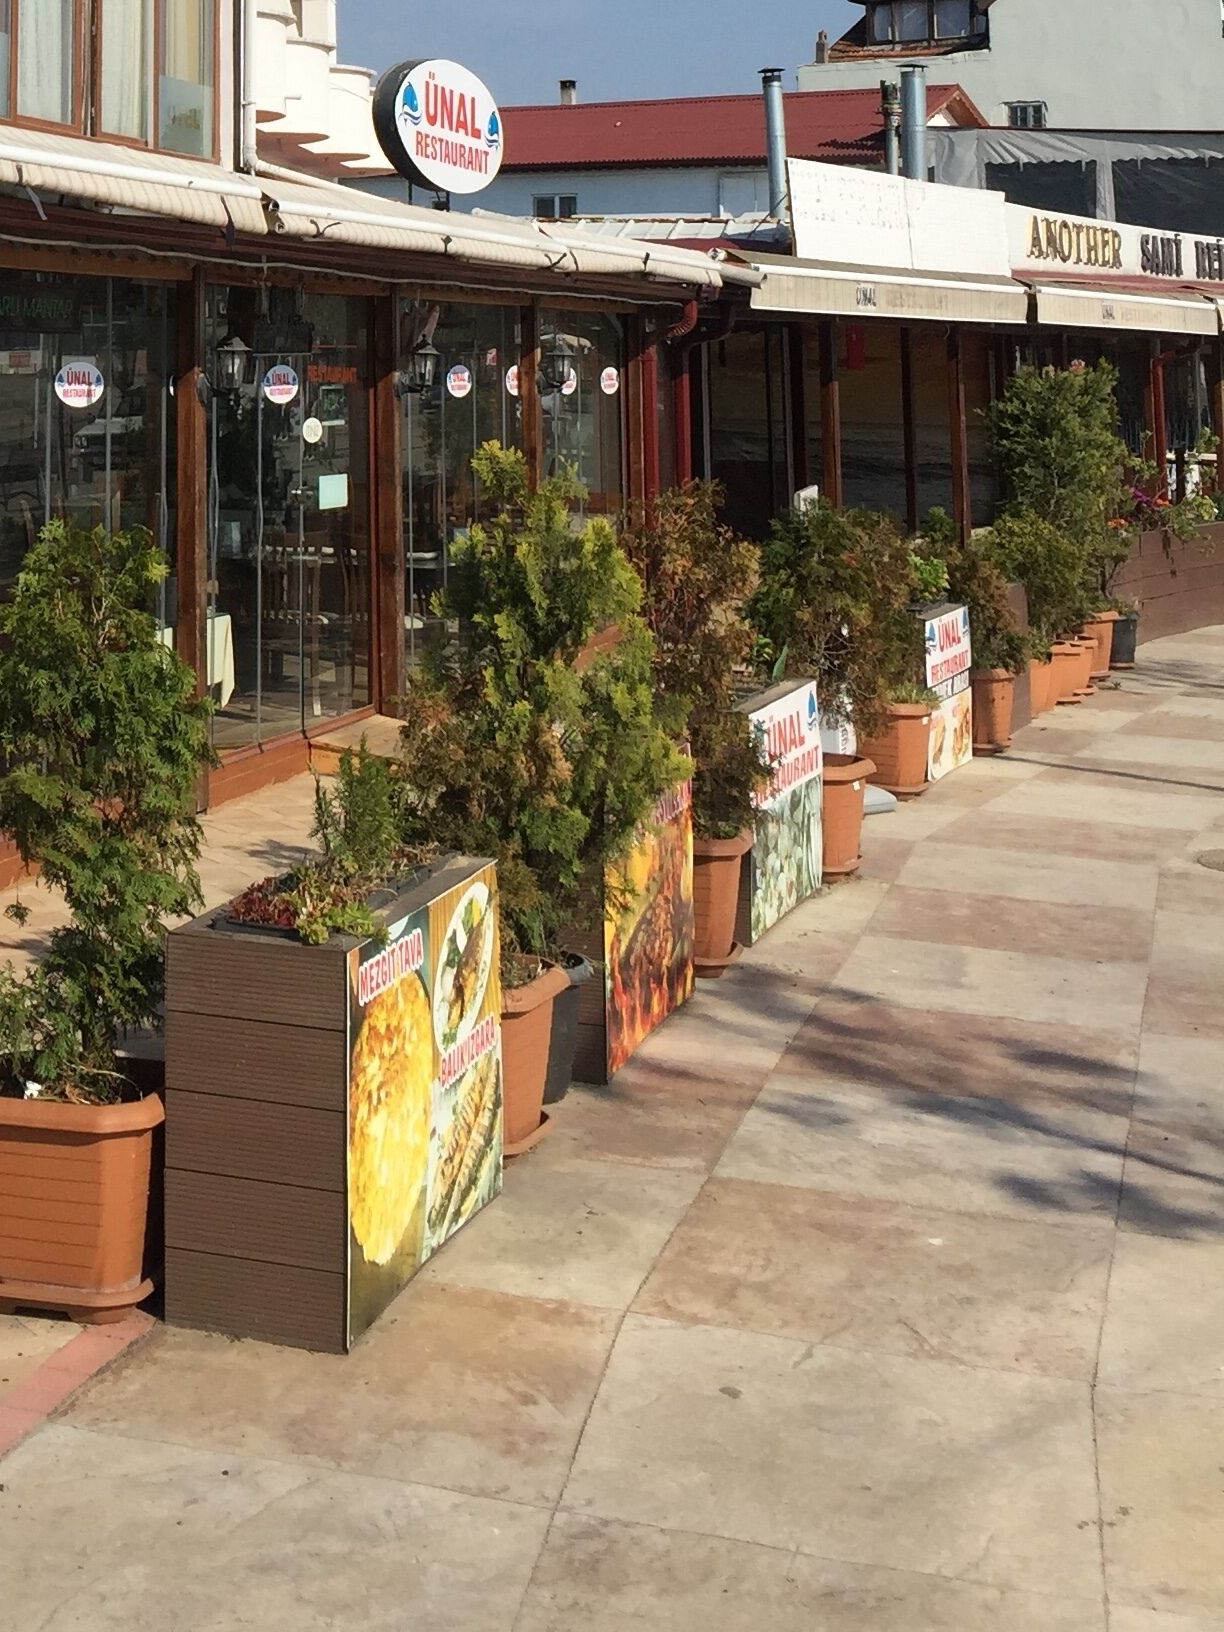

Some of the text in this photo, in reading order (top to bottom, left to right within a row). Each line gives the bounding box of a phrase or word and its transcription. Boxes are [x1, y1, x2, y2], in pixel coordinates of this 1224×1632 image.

[425, 71, 482, 140] ÜNAL
[415, 130, 490, 175] RESTAURANT
[1027, 215, 1123, 269] ANOTHER
[66, 367, 93, 386] ÜNAL
[937, 617, 962, 652] ÜNAL
[931, 649, 969, 684] RESTAURANT
[398, 930, 424, 975] TAVA
